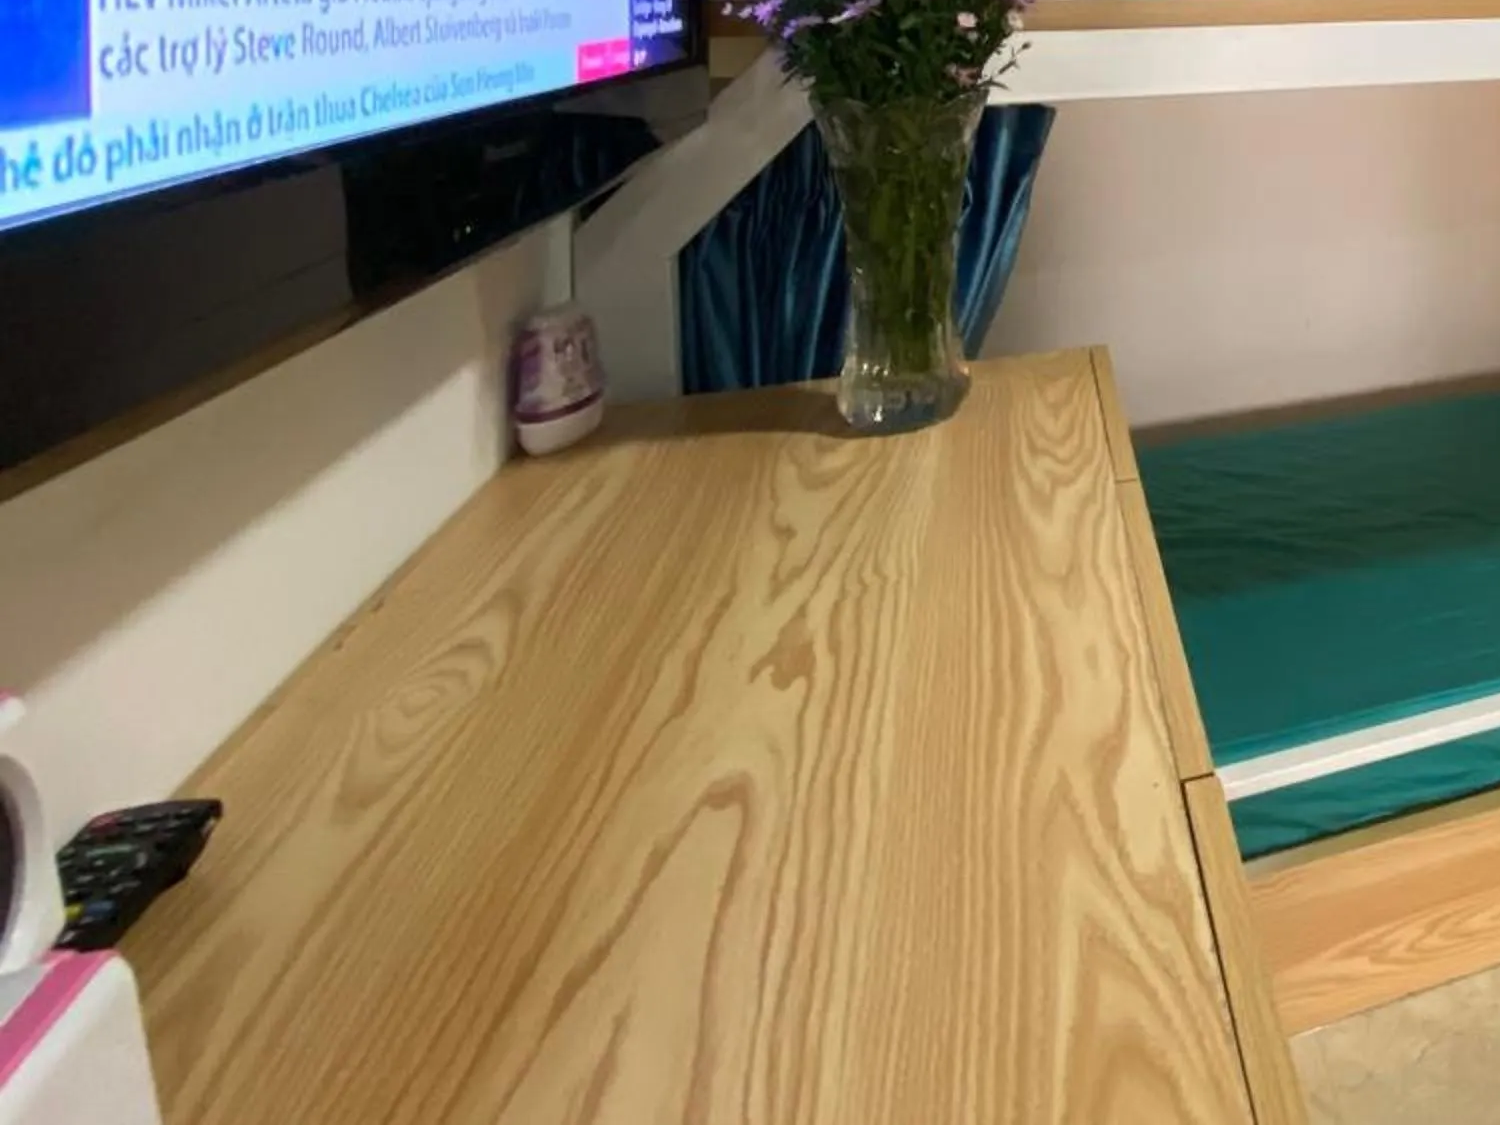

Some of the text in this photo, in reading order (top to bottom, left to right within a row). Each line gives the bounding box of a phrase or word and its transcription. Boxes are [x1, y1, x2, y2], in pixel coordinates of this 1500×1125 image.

[100, 31, 149, 79] các
[233, 26, 296, 65] Steve
[302, 22, 369, 56] Round,
[373, 15, 422, 49] Albert
[314, 91, 355, 127] thua
[361, 79, 420, 117] Chelsea
